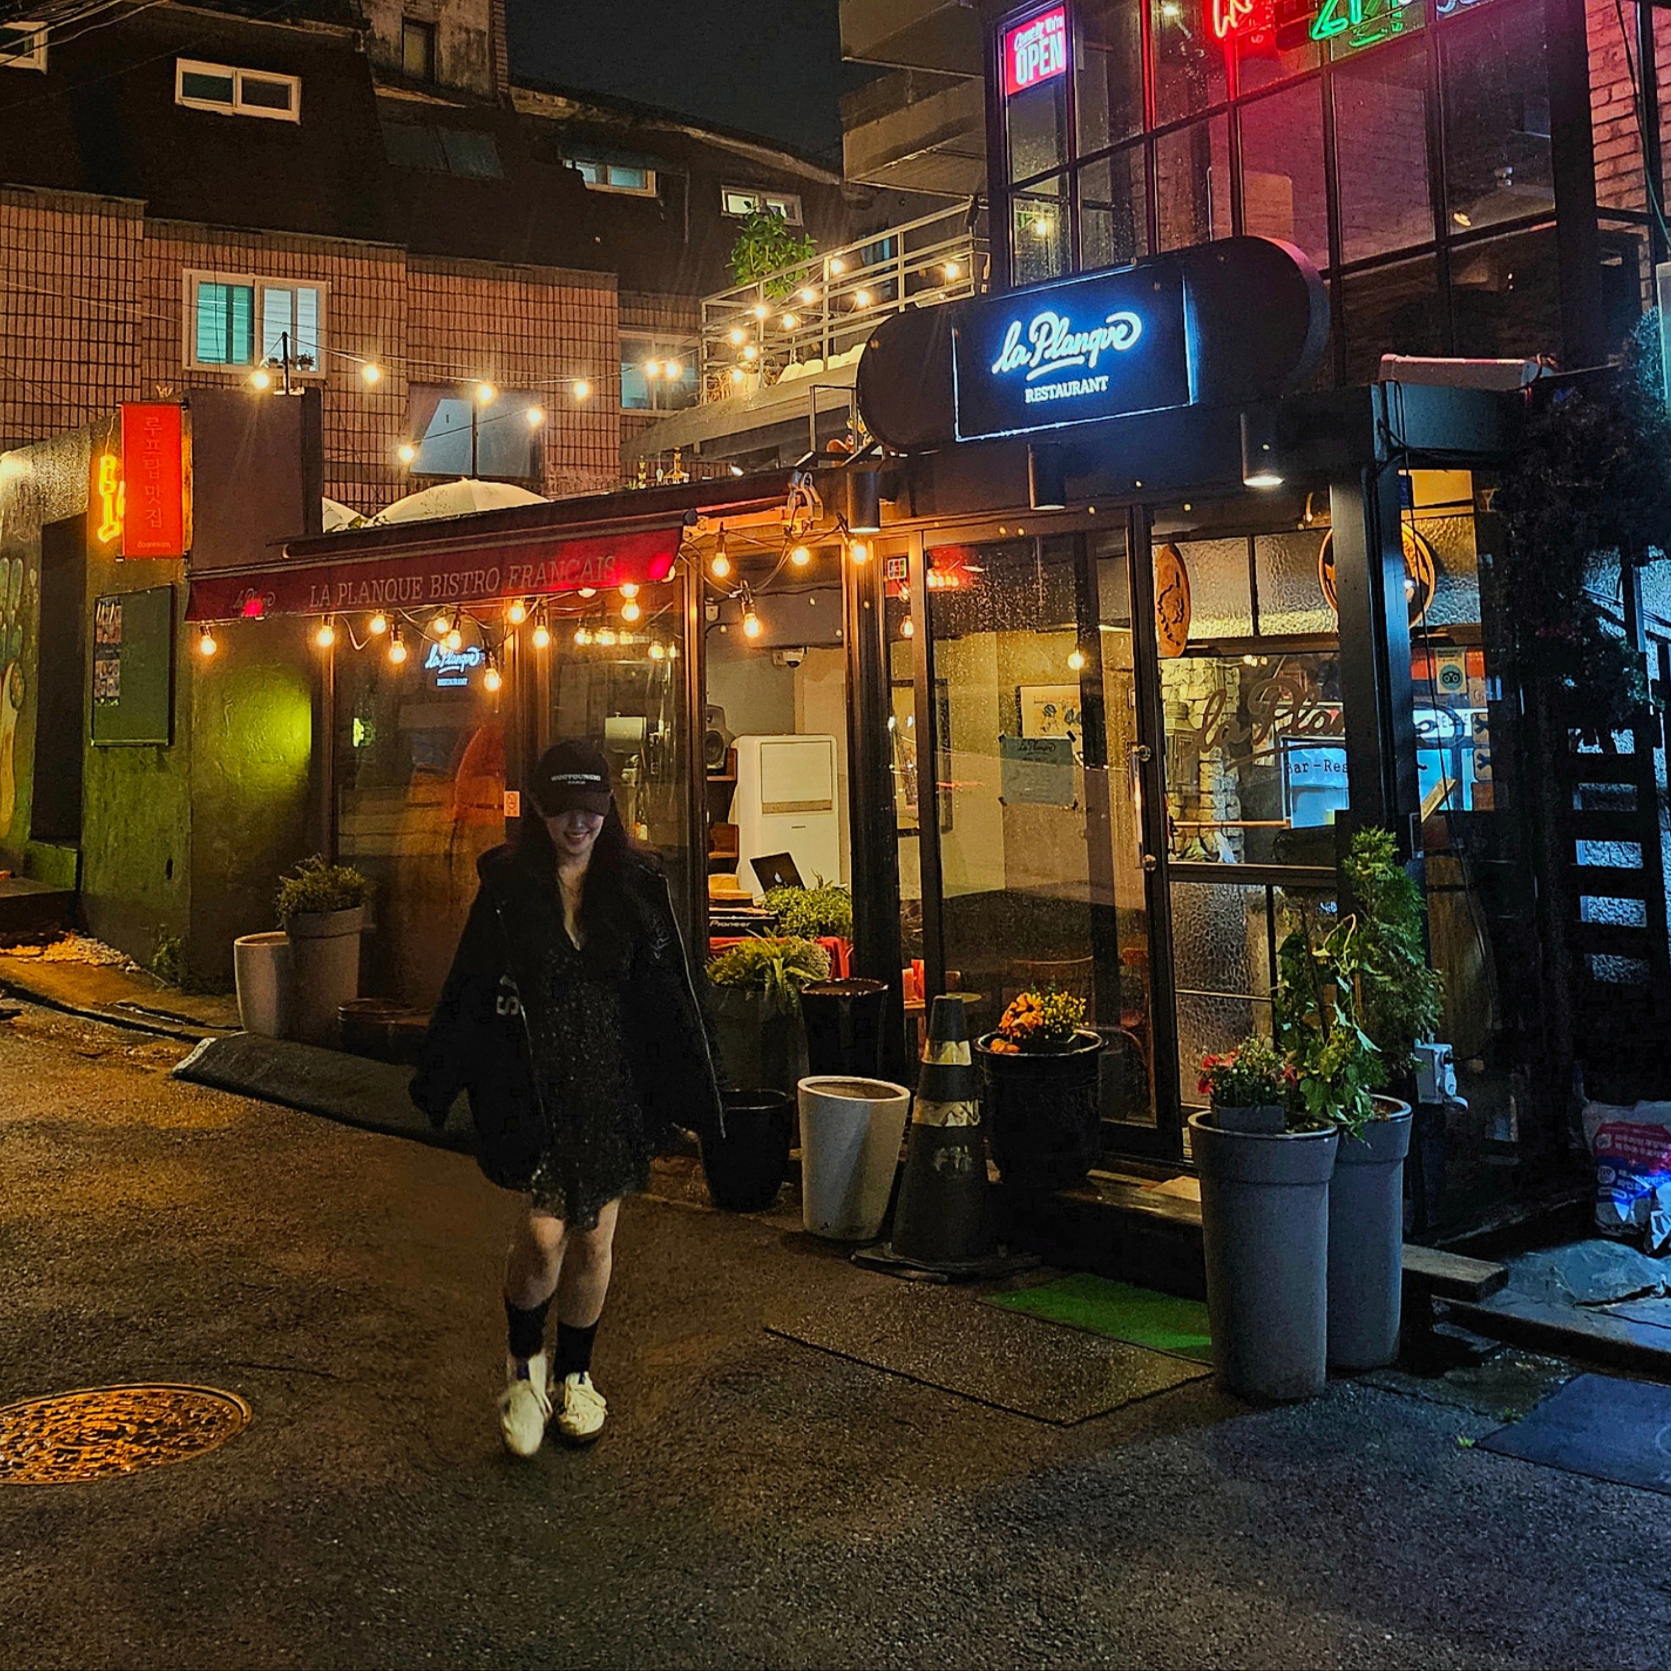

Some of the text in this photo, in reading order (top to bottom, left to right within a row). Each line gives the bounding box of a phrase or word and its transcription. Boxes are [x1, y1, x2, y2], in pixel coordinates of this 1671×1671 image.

[1015, 31, 1062, 85] OPEN
[991, 311, 1142, 375] la Planque
[1025, 375, 1109, 403] RESTAURANT
[143, 416, 162, 480] 루프탑
[144, 484, 163, 529] 맛집
[309, 585, 331, 608] LA
[337, 576, 424, 606] PLANQUE
[429, 567, 500, 599] BISTRO
[1286, 758, 1347, 774] Bar-Res
[709, 919, 751, 928] Pioneer
